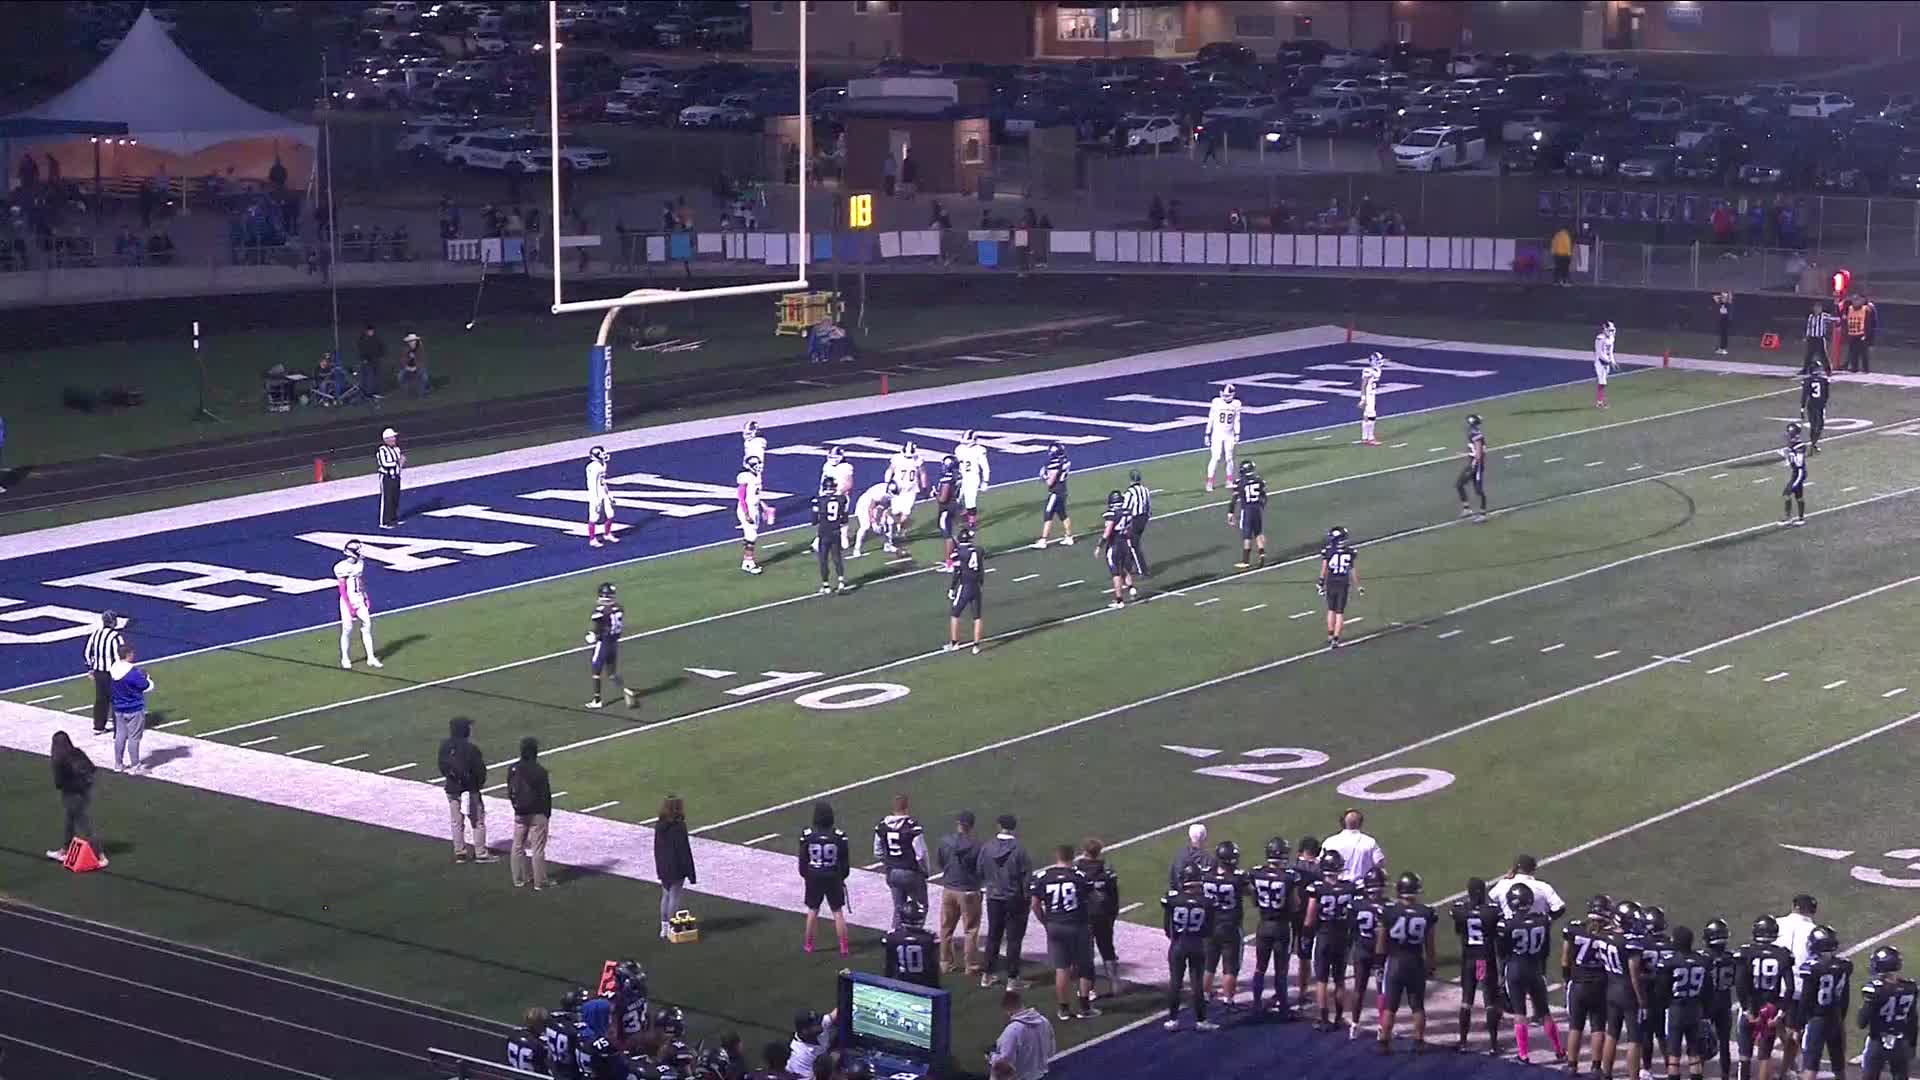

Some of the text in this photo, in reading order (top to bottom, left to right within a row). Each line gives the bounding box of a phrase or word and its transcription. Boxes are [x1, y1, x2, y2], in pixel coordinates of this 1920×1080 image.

[850, 194, 873, 228] 18
[1810, 382, 1822, 399] 3
[1219, 411, 1235, 425] 88
[900, 470, 915, 483] 70
[1244, 483, 1261, 503] 15
[827, 501, 840, 521] 9
[967, 551, 979, 571] 4
[724, 670, 911, 710] 10
[1193, 746, 1457, 801] 20
[887, 832, 903, 856] 5
[1046, 882, 1078, 911] 78
[1173, 906, 1205, 932] 99
[1390, 916, 1427, 945] 49
[1512, 926, 1545, 955] 30
[897, 945, 924, 973] 10
[1672, 966, 1705, 998] 29
[593, 1037, 610, 1050] 75
